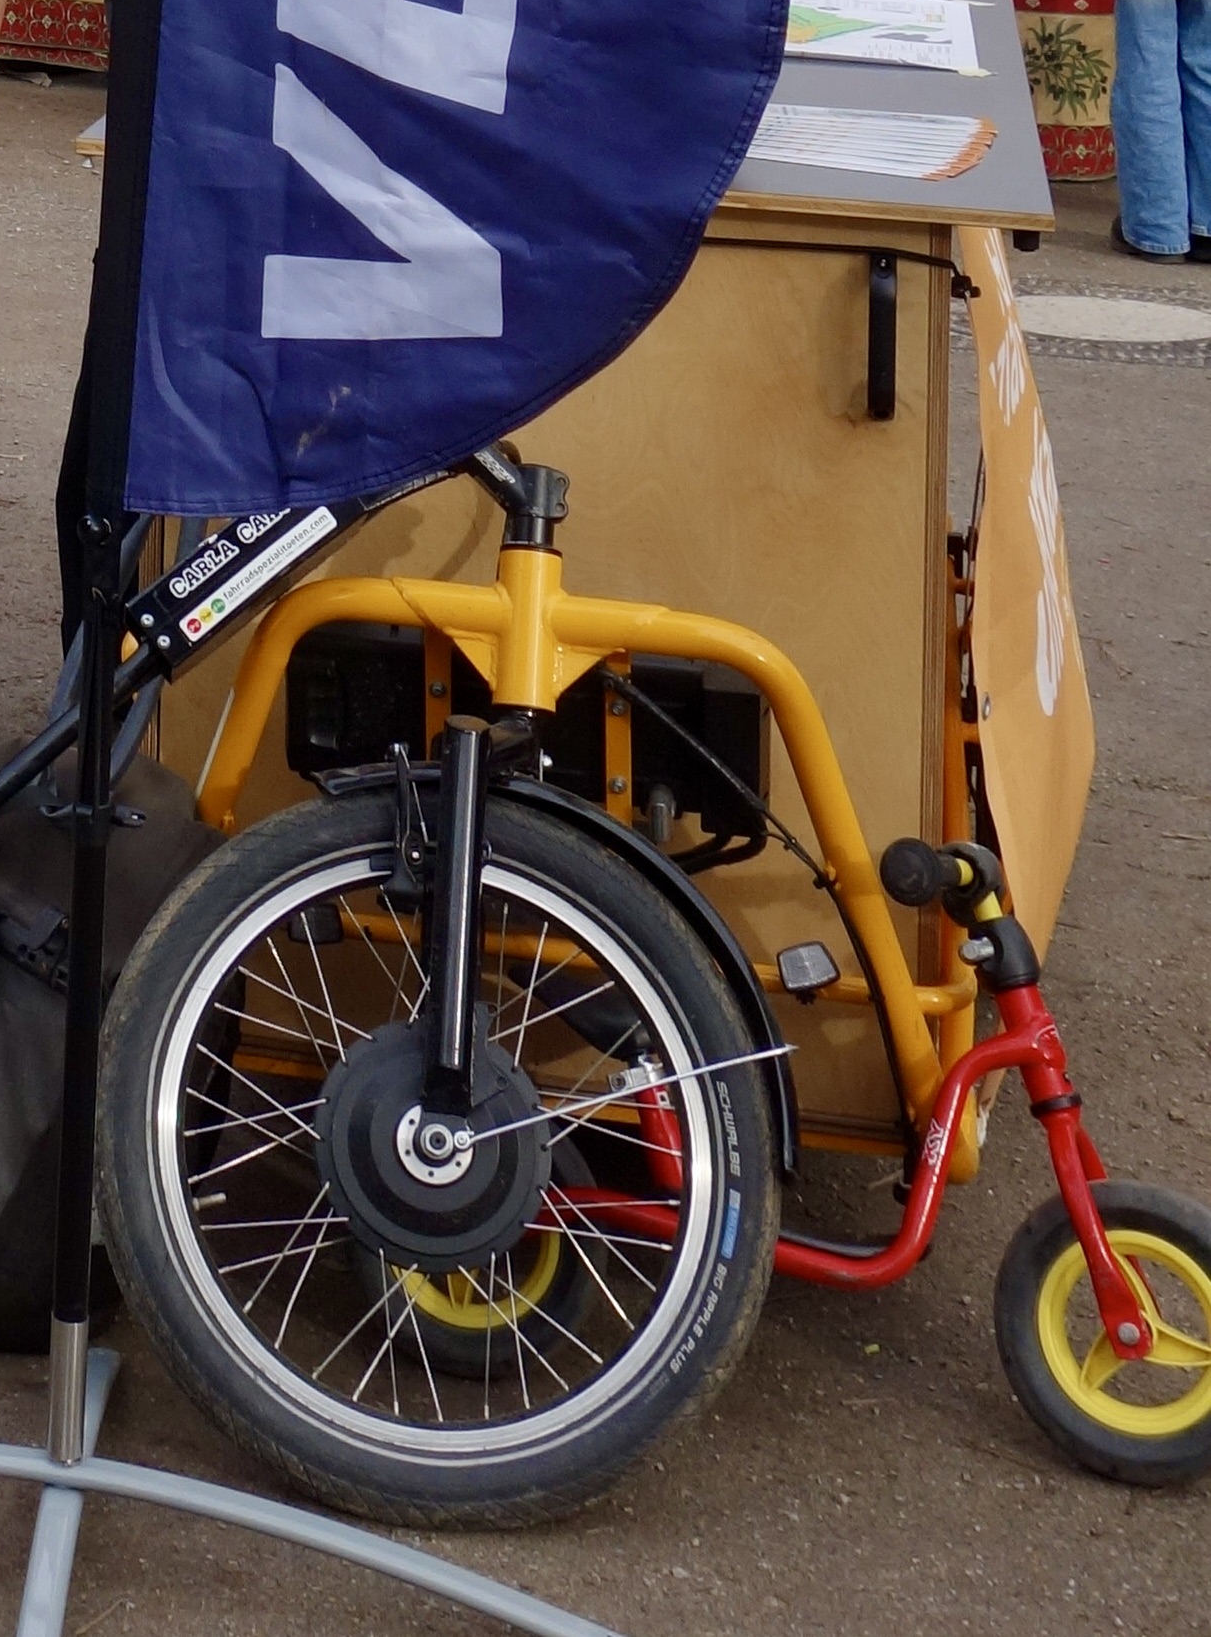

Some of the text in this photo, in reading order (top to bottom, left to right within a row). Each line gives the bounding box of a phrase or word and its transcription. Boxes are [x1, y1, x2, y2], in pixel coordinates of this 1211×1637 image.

[169, 537, 240, 599] CARLA
[223, 513, 329, 601] fahrradspezialitaeten.com
[715, 1080, 741, 1178] SCHWALBE
[670, 1262, 728, 1374] BIG APPLE PLUS
